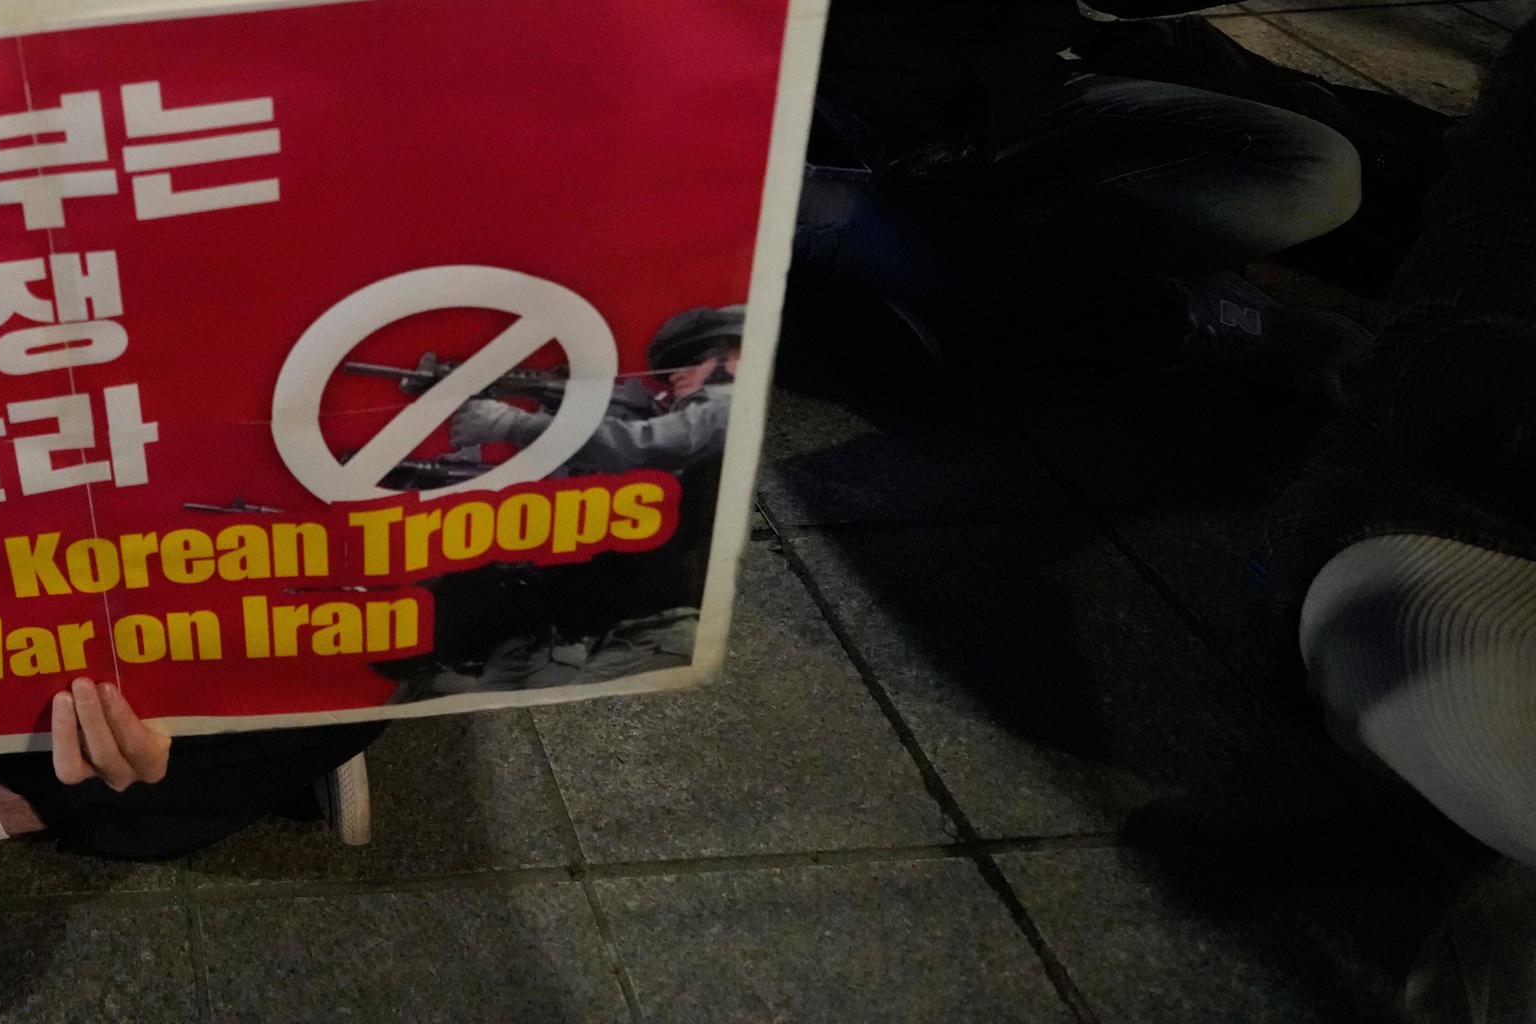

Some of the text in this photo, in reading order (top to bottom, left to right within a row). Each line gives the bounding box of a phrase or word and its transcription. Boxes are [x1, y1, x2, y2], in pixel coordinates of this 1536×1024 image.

[8, 519, 332, 601] Korean
[348, 477, 665, 579] Troops
[111, 606, 227, 666] on
[241, 591, 422, 658] Iran
